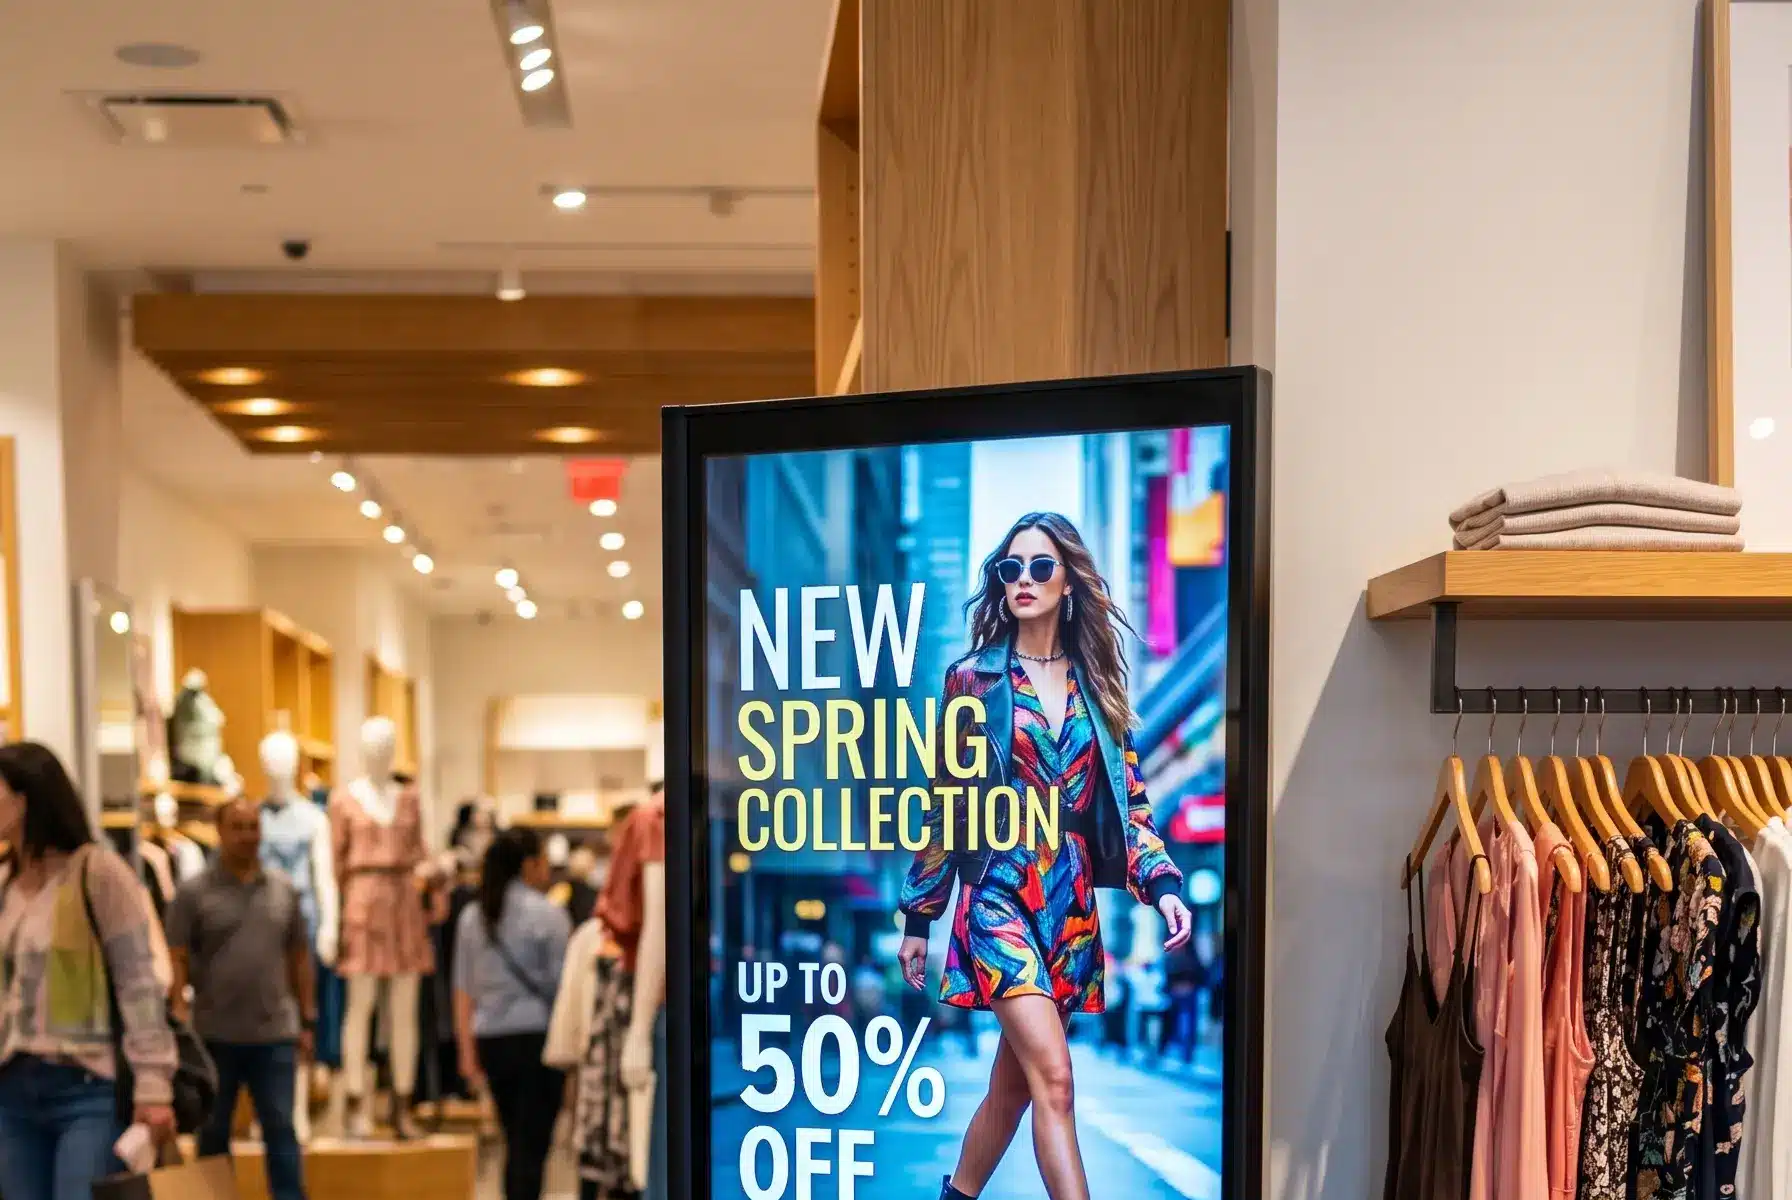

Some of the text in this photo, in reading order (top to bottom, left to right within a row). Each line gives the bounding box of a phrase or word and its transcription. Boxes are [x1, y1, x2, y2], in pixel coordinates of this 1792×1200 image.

[740, 582, 924, 692] NEW
[737, 696, 988, 781] SPRING
[737, 785, 1060, 852] COLLECTION
[738, 962, 846, 1005] UP TO
[739, 1014, 946, 1119] 50%
